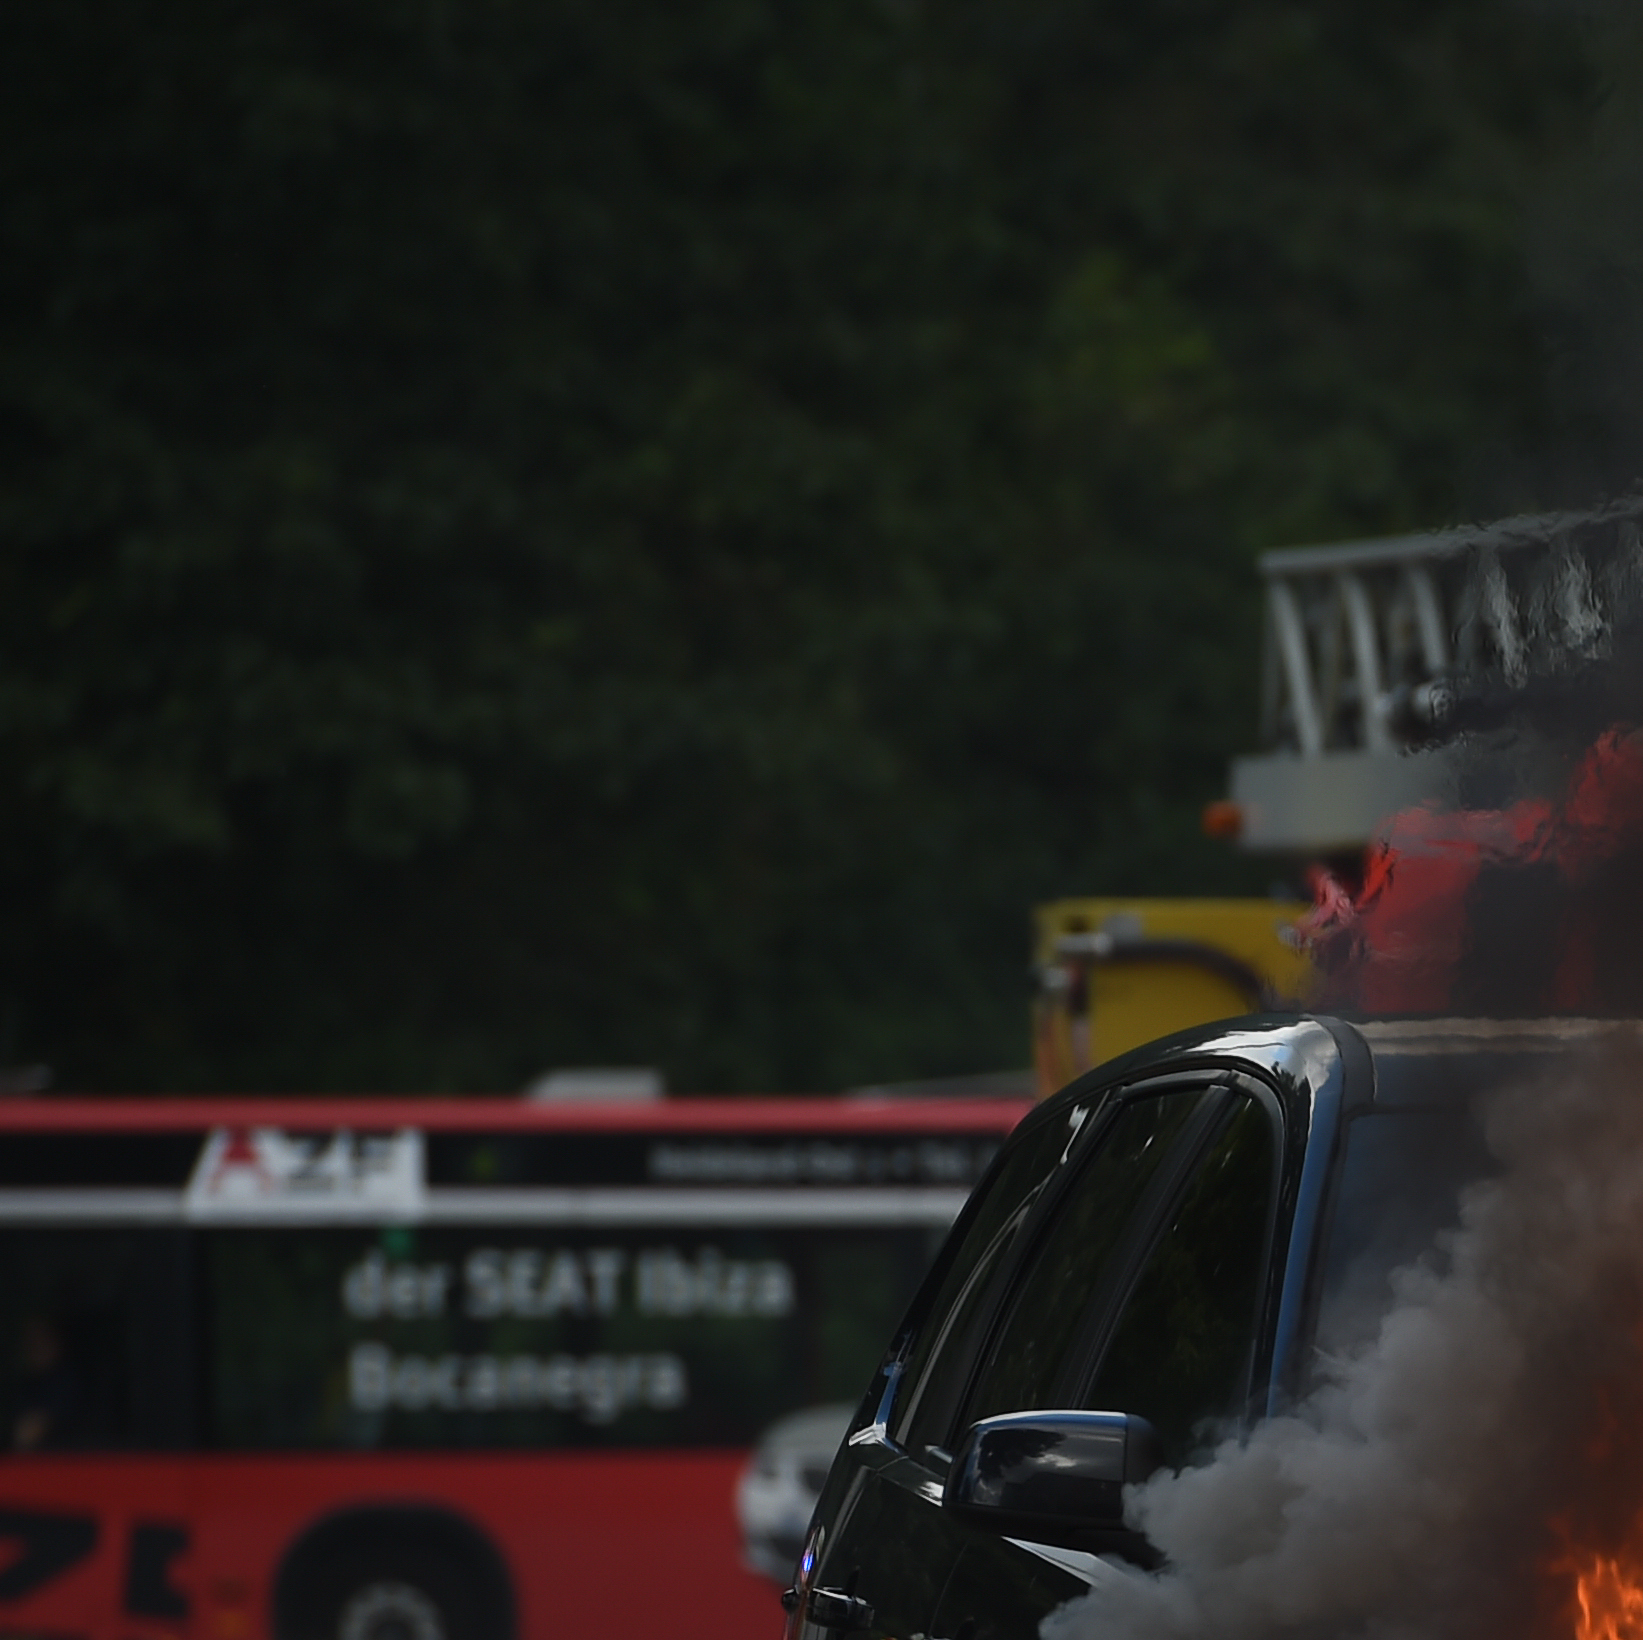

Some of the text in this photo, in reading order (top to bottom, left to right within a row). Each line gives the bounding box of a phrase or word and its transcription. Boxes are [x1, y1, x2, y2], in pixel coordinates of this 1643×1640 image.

[342, 1245, 796, 1319] der SEAT Ibiza
[349, 1342, 688, 1425] Bocanegra
